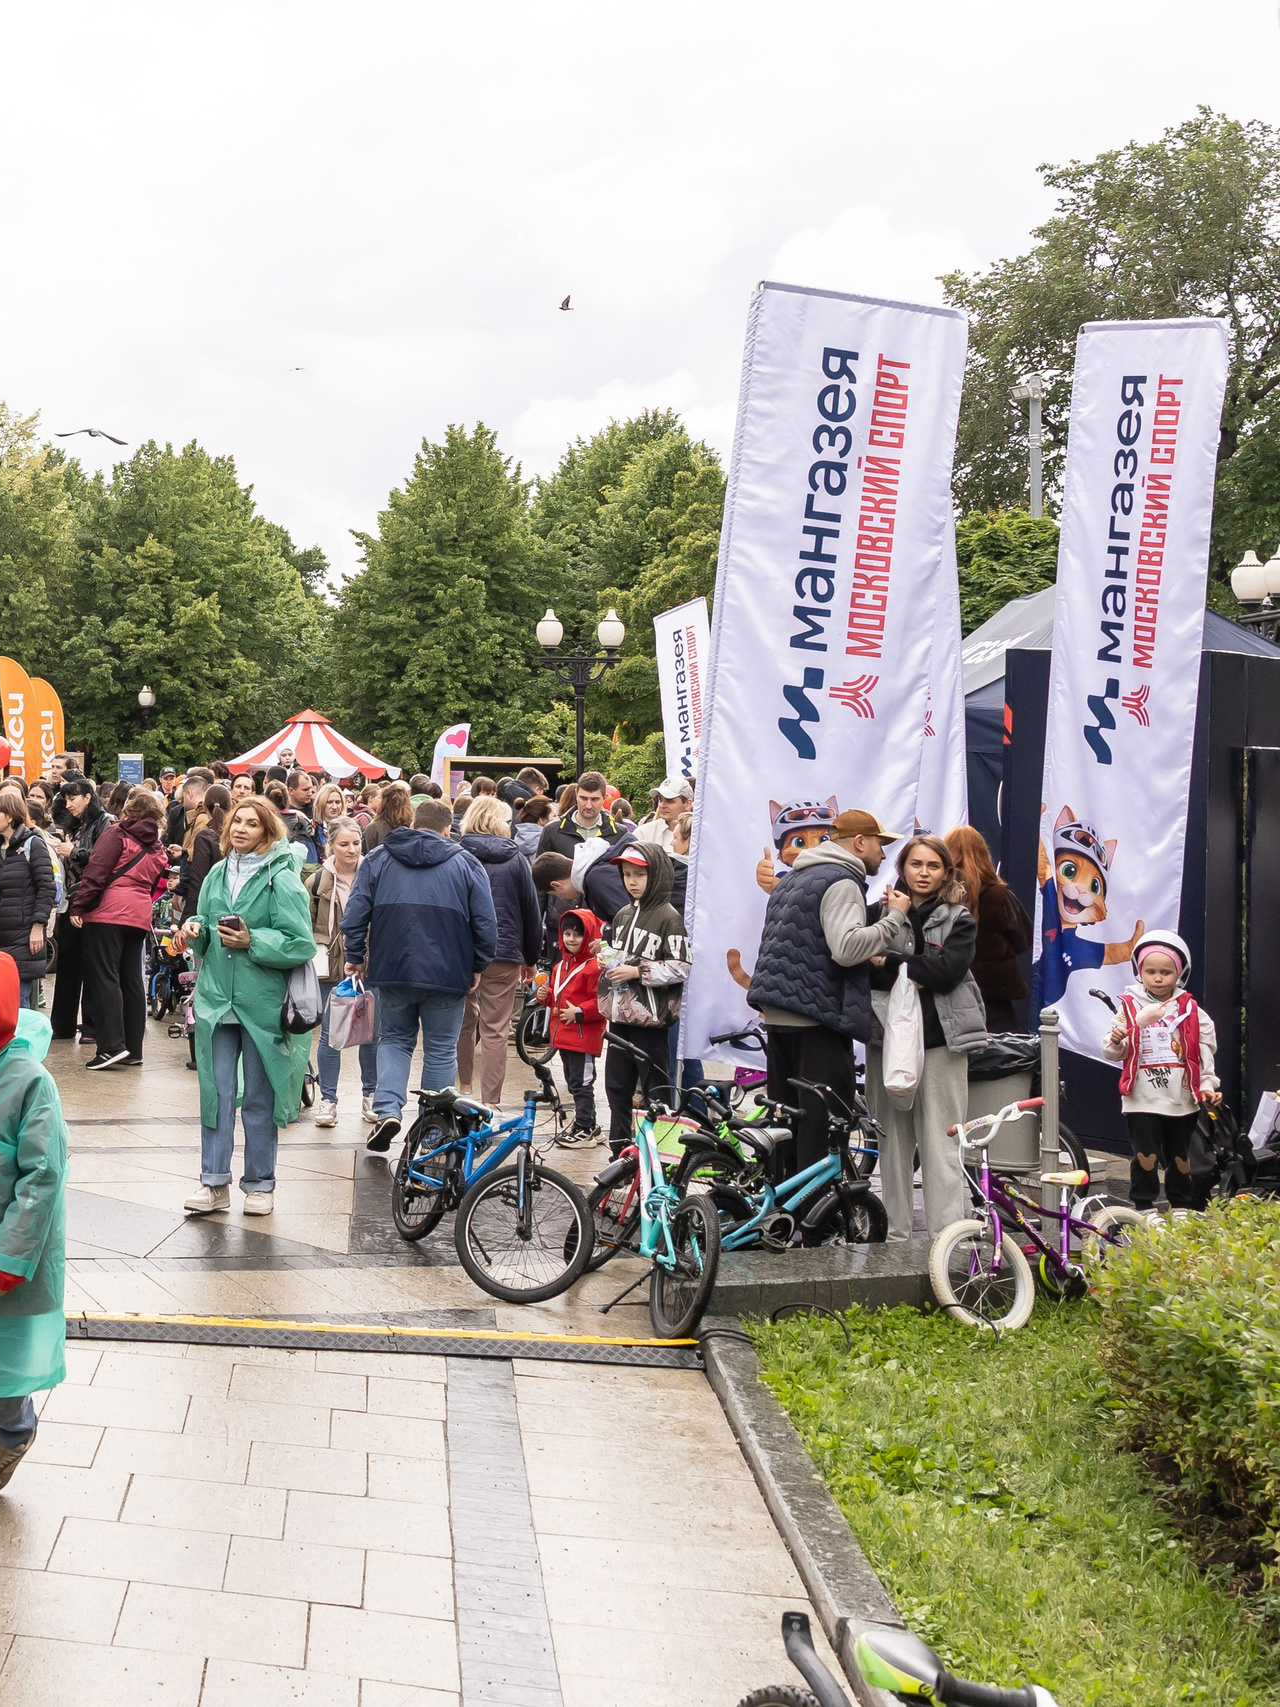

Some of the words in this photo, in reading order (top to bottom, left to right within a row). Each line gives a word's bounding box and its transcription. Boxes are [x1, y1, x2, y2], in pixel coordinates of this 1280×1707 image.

[868, 353, 910, 449] СПОРТ
[1150, 374, 1183, 464] СПОРТ
[845, 455, 901, 658] МОСКОВСКИЙ
[1132, 474, 1172, 668] МОСКОВСКИЙ
[685, 625, 697, 660] СПОРТ
